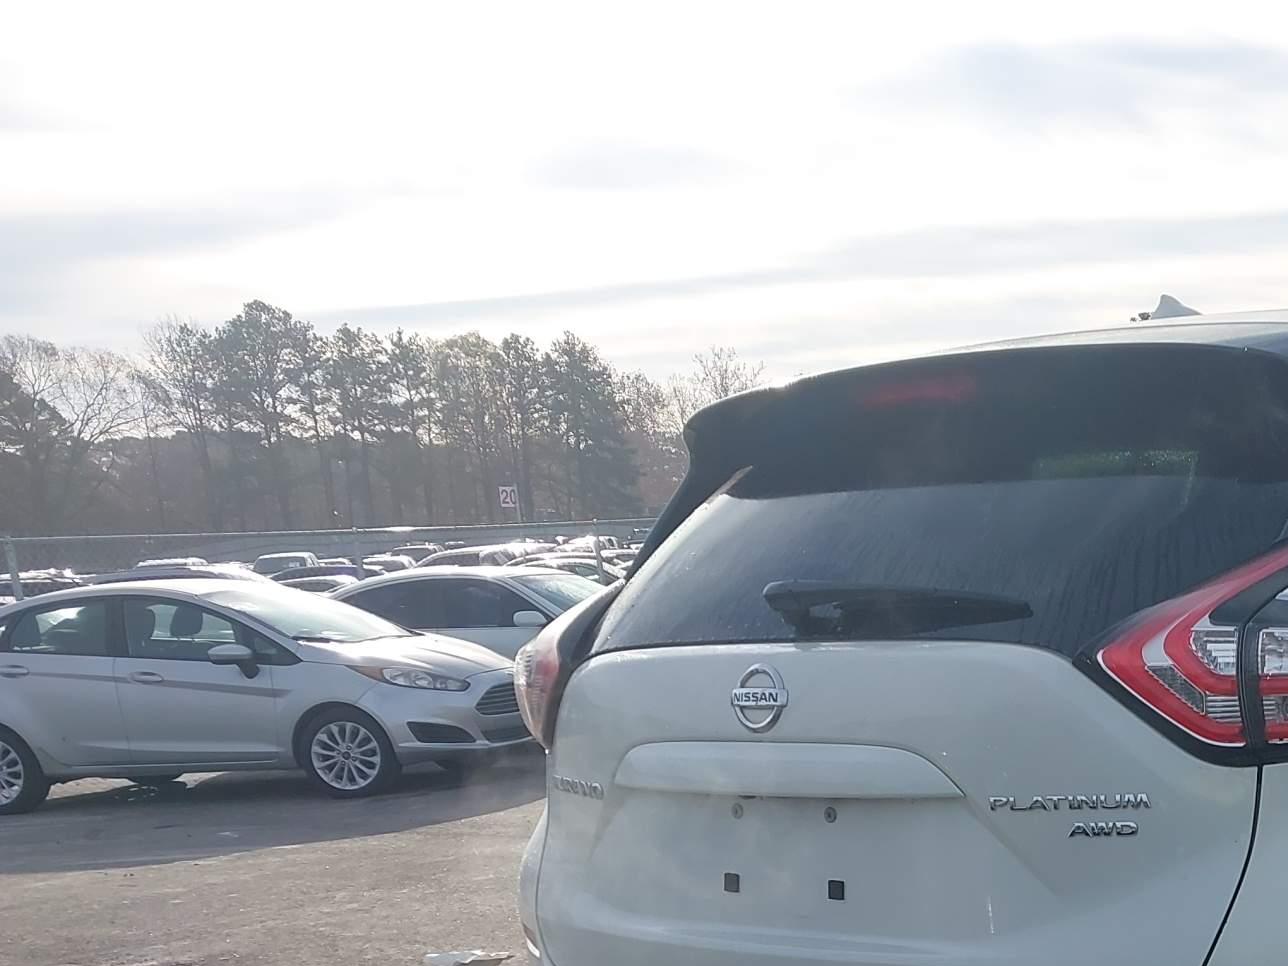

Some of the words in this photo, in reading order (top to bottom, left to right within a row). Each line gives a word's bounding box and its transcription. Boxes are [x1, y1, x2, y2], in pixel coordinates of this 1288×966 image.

[500, 489, 516, 505] 20
[733, 691, 778, 703] NISSAN
[988, 793, 1151, 811] PLATINUM
[1067, 821, 1139, 838] AWD
